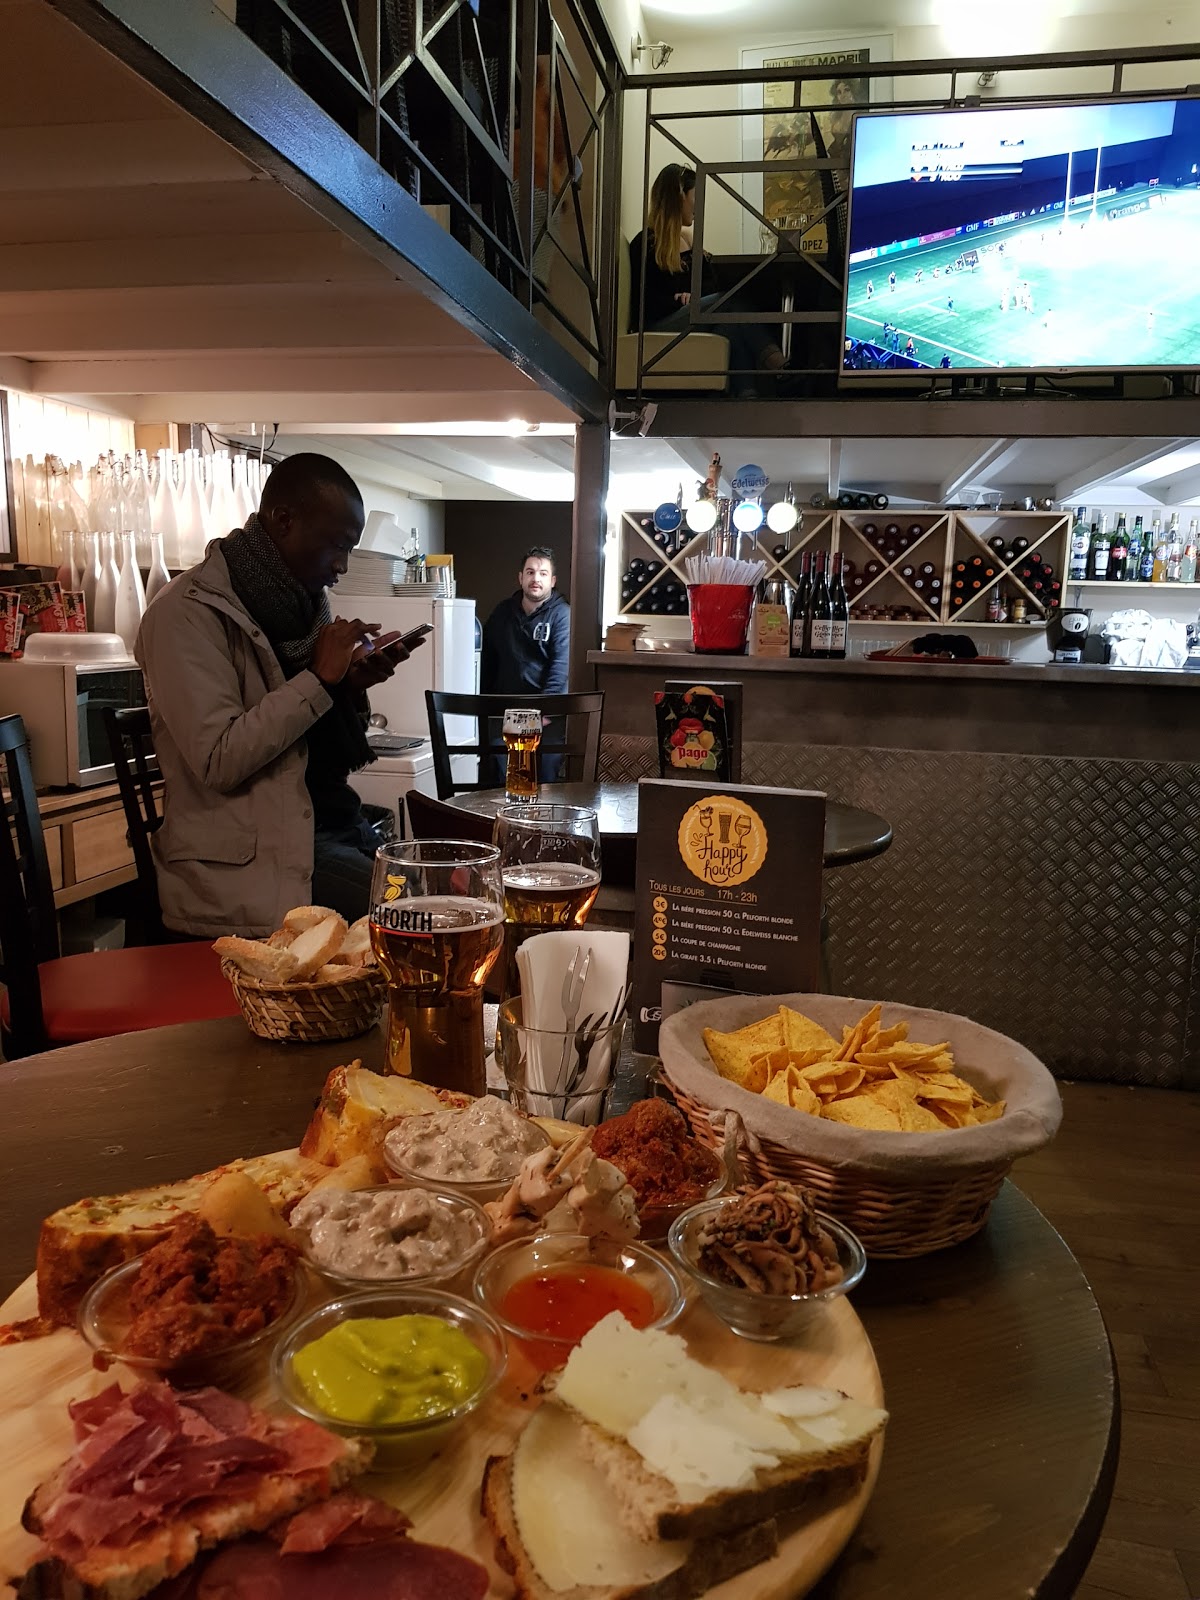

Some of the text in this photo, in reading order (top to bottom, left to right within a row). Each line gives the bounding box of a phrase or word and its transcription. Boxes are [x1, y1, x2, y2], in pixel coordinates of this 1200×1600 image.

[966, 222, 980, 233] GMF
[802, 239, 823, 251] OPEZ
[731, 477, 769, 489] Edelweiss
[695, 836, 748, 875] Happy
[703, 859, 735, 884] hour
[669, 885, 681, 893] LES
[683, 887, 705, 897] JOURS
[717, 889, 733, 900] 17h
[740, 892, 758, 903] 23h
[655, 900, 666, 908] 3€
[722, 910, 733, 918] 50
[655, 932, 665, 940] 5€
[722, 926, 732, 934] 50
[699, 955, 712, 963] 3.5
